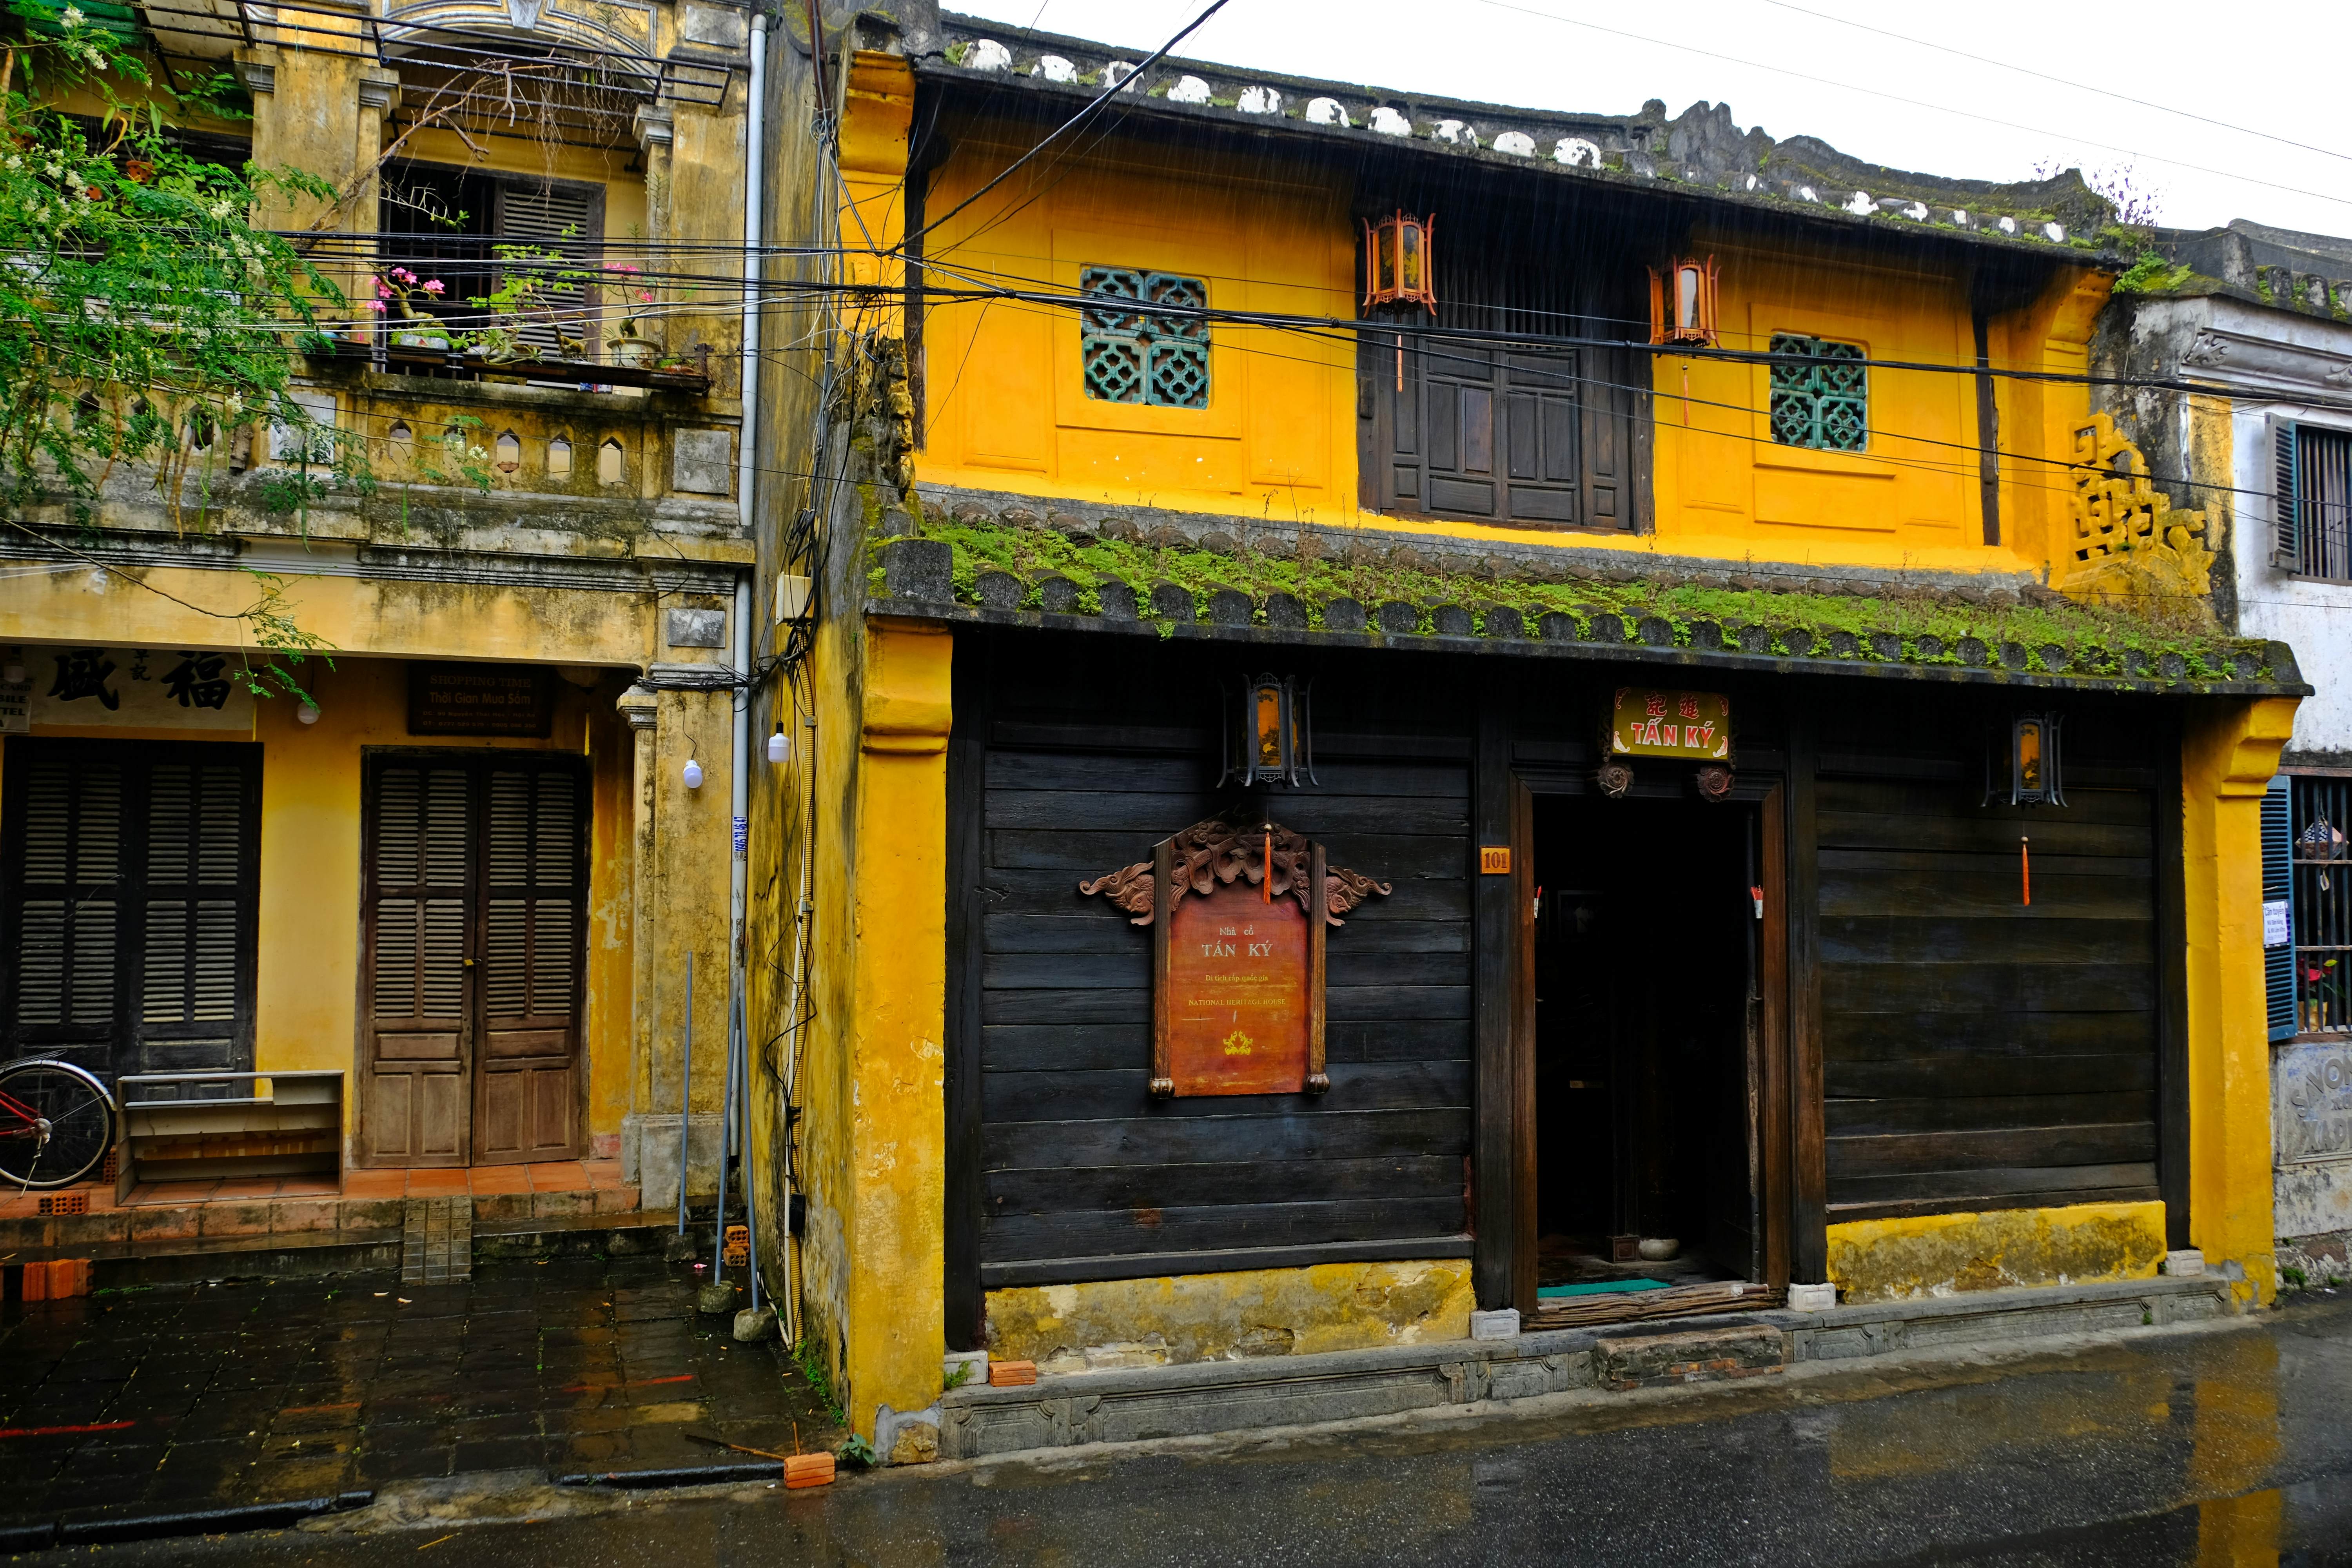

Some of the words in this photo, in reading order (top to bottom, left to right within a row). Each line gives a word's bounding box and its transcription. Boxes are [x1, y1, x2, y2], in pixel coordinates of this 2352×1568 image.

[430, 675, 495, 686] SHOPPING
[499, 677, 531, 688] TIME
[430, 691, 452, 703] Thời
[455, 692, 478, 704] Gian
[482, 693, 505, 704] Mua
[508, 689, 530, 704] Sắm
[1631, 717, 1678, 747] TẤN
[1684, 720, 1715, 748] KÝ
[1485, 852, 1507, 868] 101
[1220, 927, 1236, 936] Nhà
[1244, 925, 1254, 936] cổ
[1201, 940, 1236, 957] TẤN
[1248, 940, 1273, 957] KÝ
[1228, 973, 1240, 983] cấp
[1241, 973, 1257, 984] quốc
[1259, 975, 1269, 983] gia
